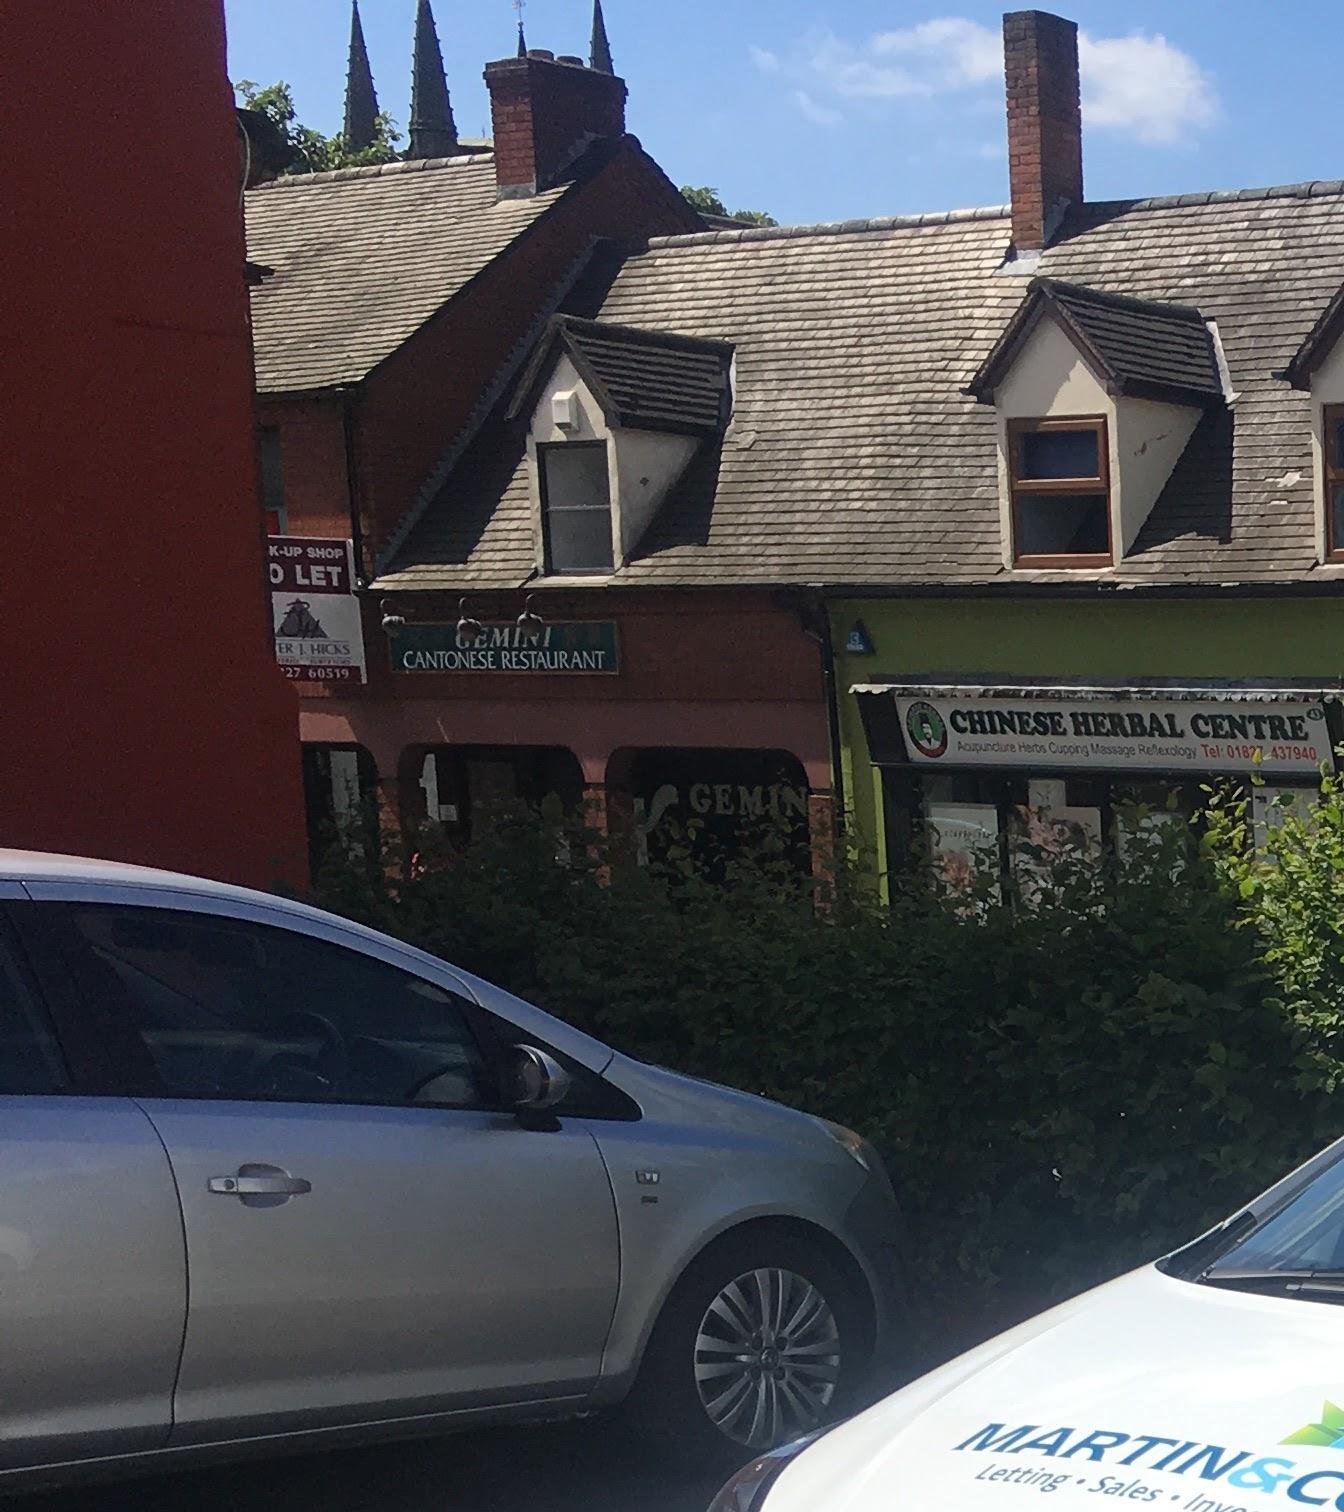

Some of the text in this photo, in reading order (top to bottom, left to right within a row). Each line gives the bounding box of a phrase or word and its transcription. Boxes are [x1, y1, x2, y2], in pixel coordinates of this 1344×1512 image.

[268, 545, 344, 559] K-UP SHOP
[269, 563, 342, 587] O LET
[278, 643, 293, 655] ER
[310, 643, 350, 655] HICKS
[403, 650, 605, 669] CANTONESE RESTAURANT
[308, 667, 349, 679] 60519
[950, 709, 1068, 736] CHINESE
[1069, 711, 1185, 738] HERBAL
[1190, 713, 1309, 741] CENTRE
[957, 741, 1016, 753] Acupuncture
[1018, 742, 1046, 754] Herbs
[1048, 742, 1089, 757] Cupping
[1090, 743, 1136, 758] Massage
[1138, 743, 1197, 759] Reflexology
[1201, 743, 1224, 758] Tel:
[1271, 746, 1317, 761] 437940
[689, 783, 808, 818] GEMIN
[974, 1463, 1074, 1493] Letting
[1087, 1475, 1164, 1503] Sales
